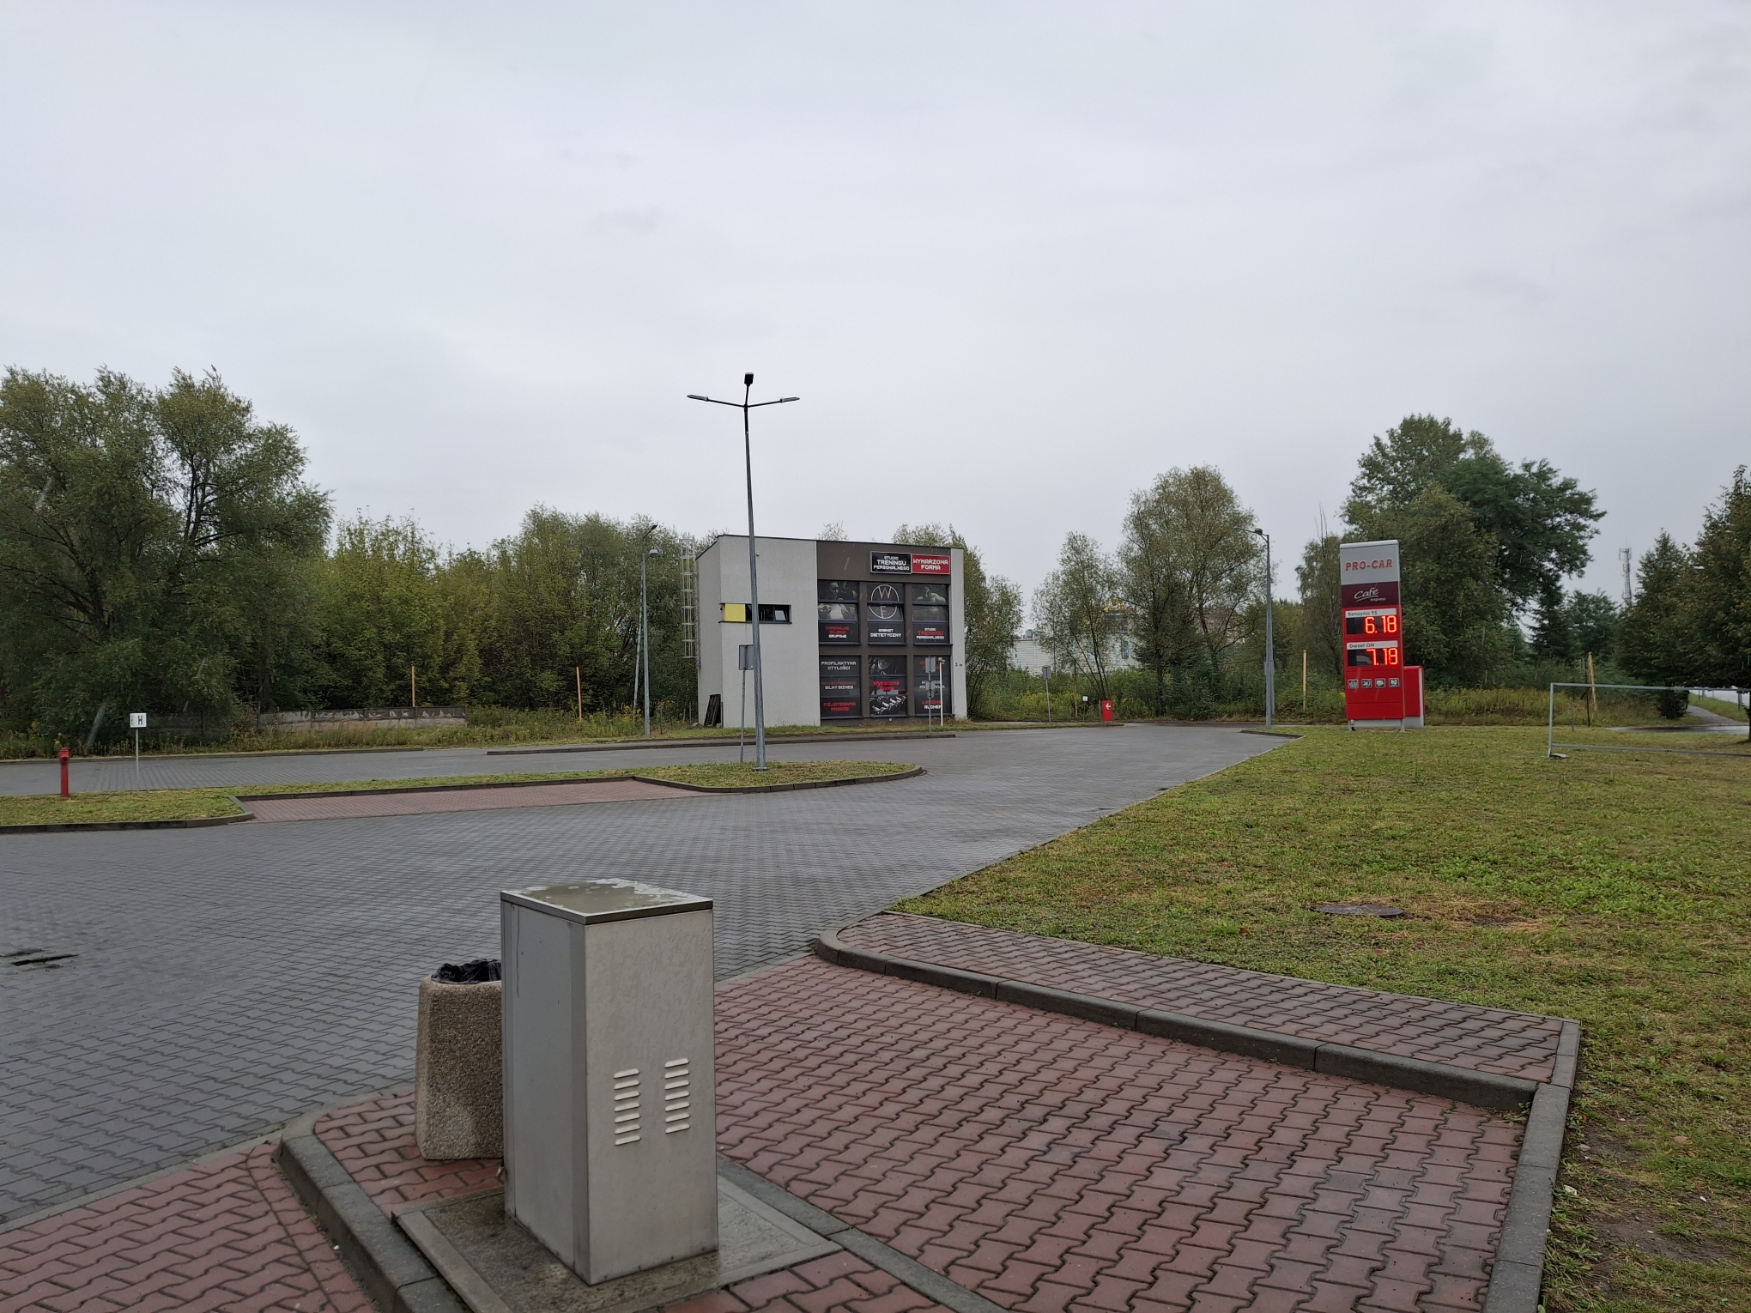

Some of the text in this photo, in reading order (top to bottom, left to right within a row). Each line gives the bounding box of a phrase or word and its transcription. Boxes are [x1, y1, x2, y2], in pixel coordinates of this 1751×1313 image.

[1345, 559, 1393, 571] PRO-CAR
[1365, 615, 1397, 634] 6.18
[1366, 648, 1398, 666] 7.18
[137, 715, 143, 726] H
